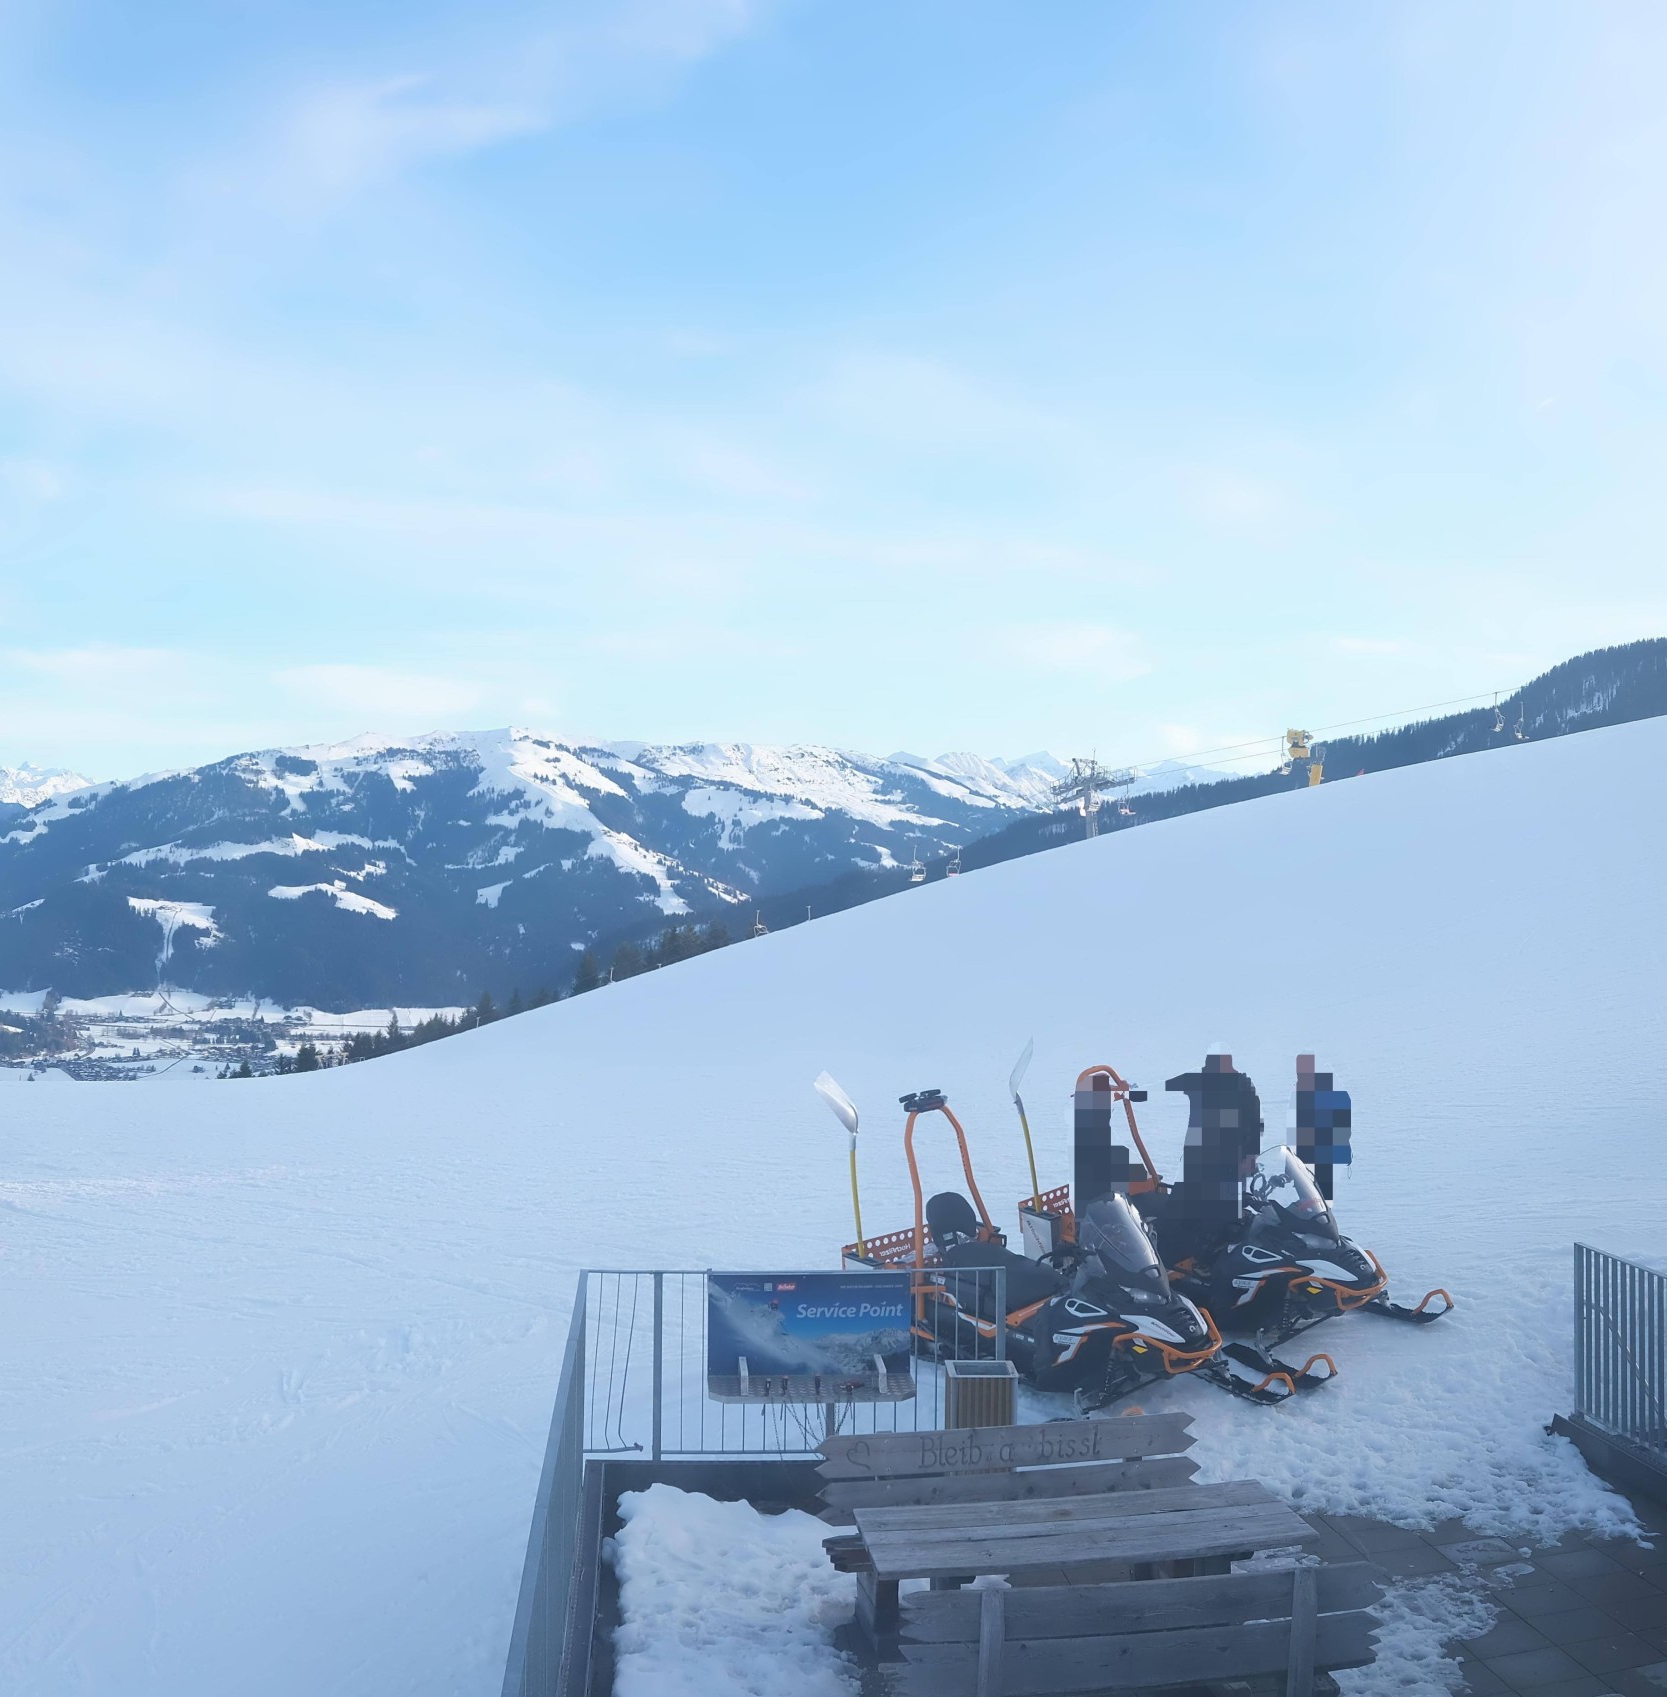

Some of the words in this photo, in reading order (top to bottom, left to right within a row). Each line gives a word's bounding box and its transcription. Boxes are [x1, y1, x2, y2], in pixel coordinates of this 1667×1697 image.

[796, 1302, 857, 1319] Service
[859, 1301, 904, 1318] Point
[919, 1434, 983, 1469] Bleib
[999, 1442, 1015, 1463] a
[1037, 1424, 1101, 1460] bissl
